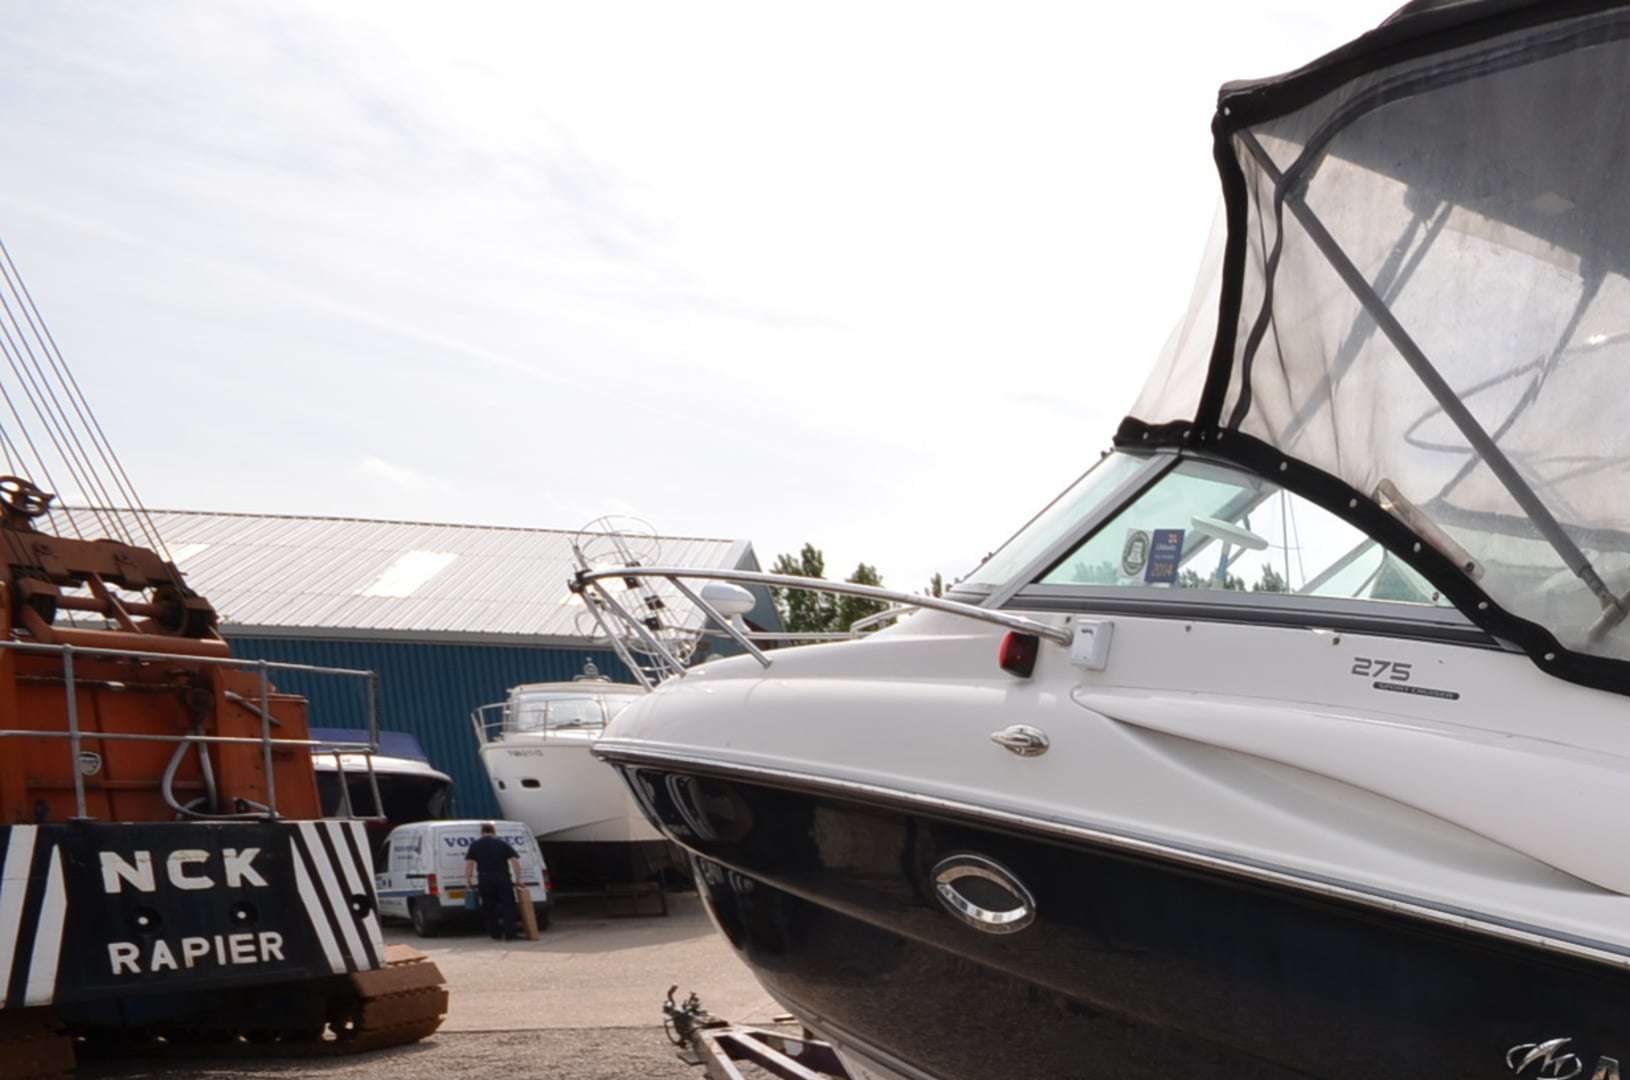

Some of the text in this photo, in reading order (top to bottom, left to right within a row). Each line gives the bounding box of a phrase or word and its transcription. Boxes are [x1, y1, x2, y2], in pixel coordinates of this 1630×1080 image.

[1351, 657, 1413, 682] 275
[99, 847, 270, 895] NCK
[108, 931, 286, 976] RAPIER
